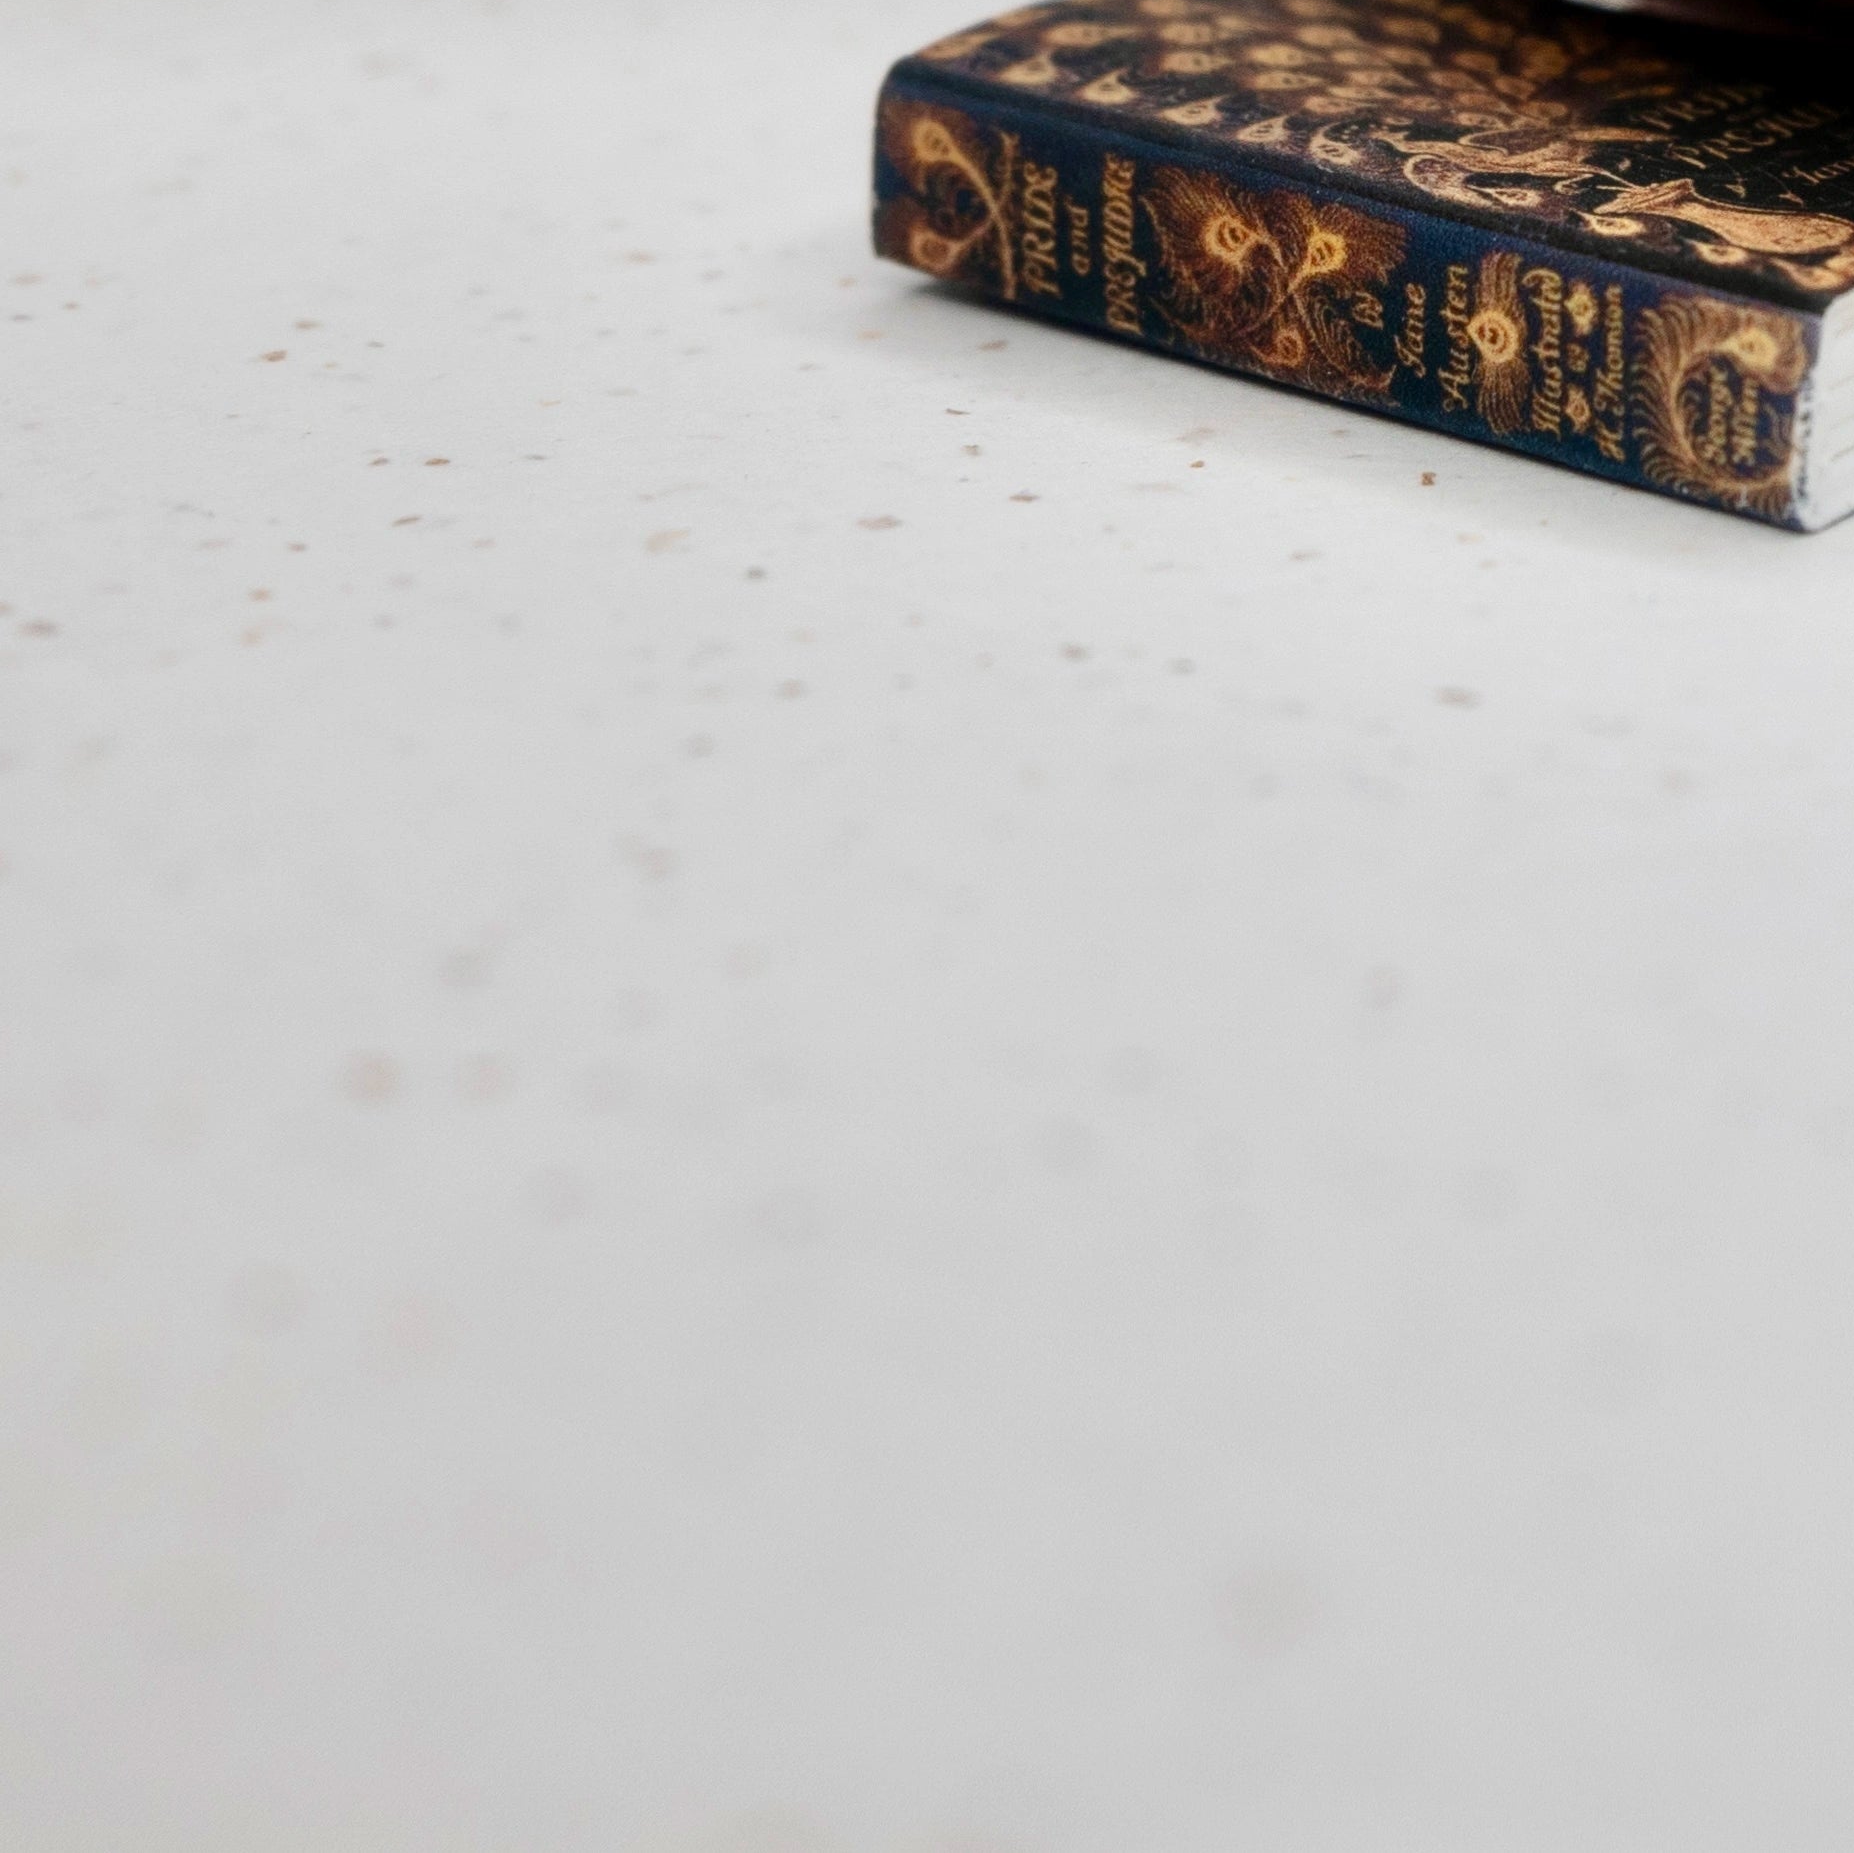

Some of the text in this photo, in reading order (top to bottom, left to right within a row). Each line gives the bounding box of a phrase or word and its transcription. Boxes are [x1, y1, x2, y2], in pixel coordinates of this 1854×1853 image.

[1020, 160, 1063, 298] PRIDE
[1066, 191, 1092, 277] and
[1395, 281, 1427, 379] Jane
[1439, 263, 1475, 411] Austen
